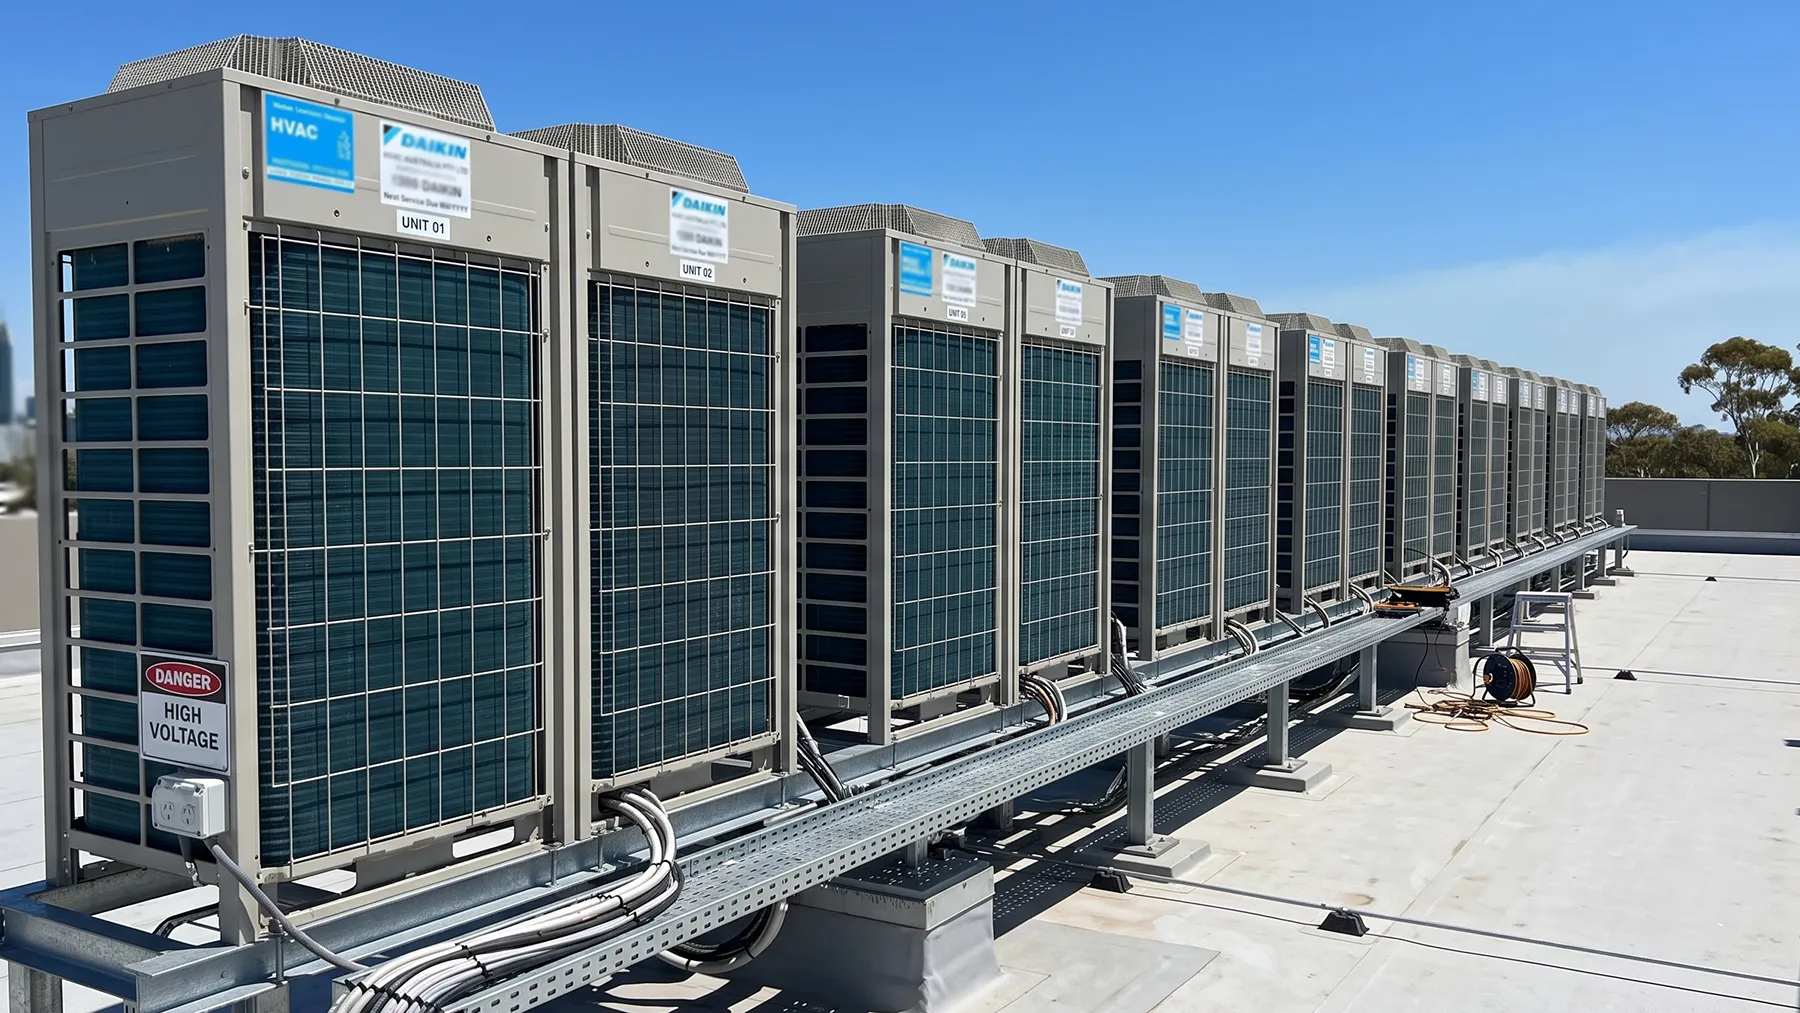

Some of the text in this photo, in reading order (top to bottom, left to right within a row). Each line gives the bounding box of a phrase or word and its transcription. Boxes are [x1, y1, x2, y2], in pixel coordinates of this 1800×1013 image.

[271, 115, 318, 140] HVAC
[400, 133, 467, 159] DAIKIN
[383, 191, 400, 200] Next
[401, 194, 425, 206] Service
[426, 199, 439, 209] Due
[682, 197, 726, 216] DAIKIN
[402, 216, 445, 234] UNIT 01
[683, 263, 713, 278] UNIT 02
[948, 308, 960, 318] UNIT
[155, 668, 212, 691] DANGER
[164, 701, 202, 725] HIGH
[149, 721, 219, 751] VOLTAGE
